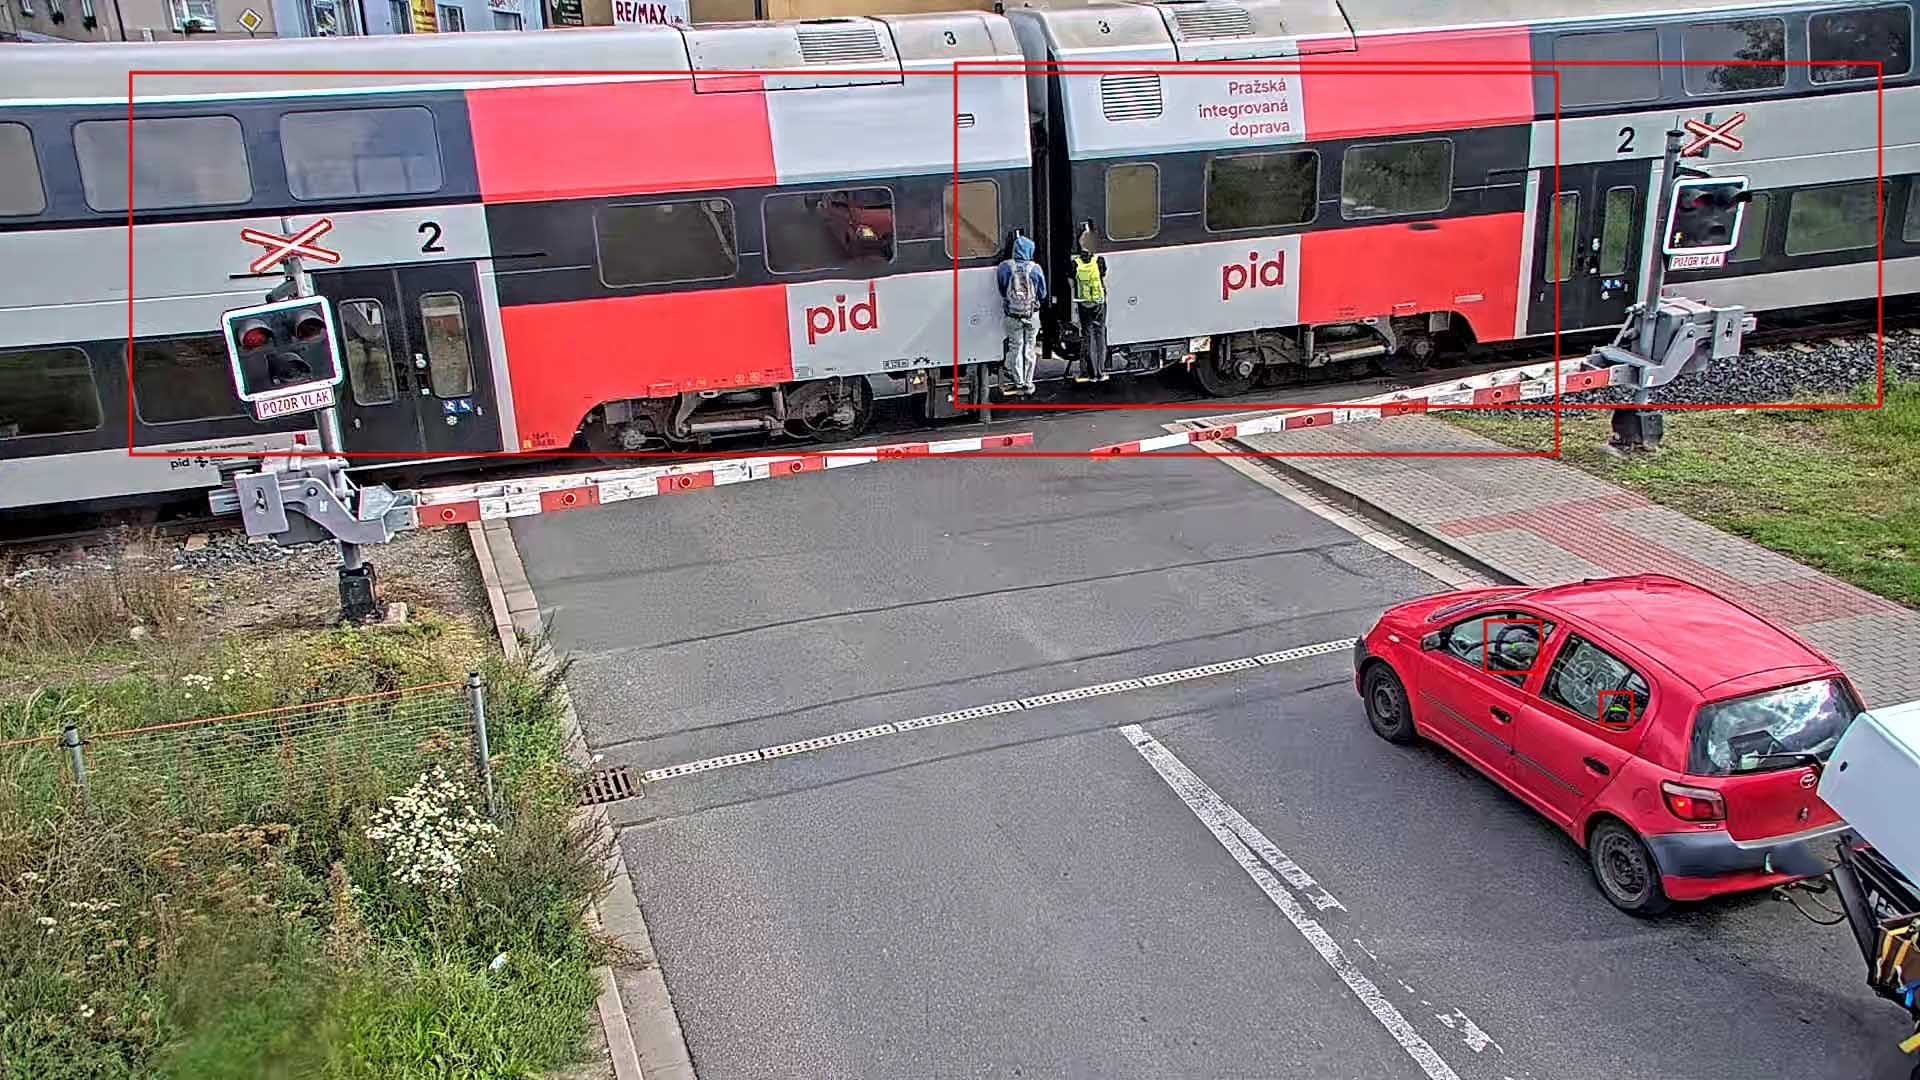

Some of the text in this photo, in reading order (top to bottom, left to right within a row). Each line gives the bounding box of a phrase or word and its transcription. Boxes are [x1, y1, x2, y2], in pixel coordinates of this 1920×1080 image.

[615, 1, 667, 25] RE/MAX
[944, 31, 957, 45] 3
[1099, 20, 1111, 34] 3
[1229, 77, 1287, 95] Pražská
[1198, 98, 1288, 119] integrovaná
[1229, 121, 1290, 138] doprava
[1617, 126, 1635, 153] 2
[418, 221, 445, 252] 2
[1222, 250, 1285, 301] pid
[806, 291, 878, 345] pid
[262, 391, 330, 415] POZOR VLAK
[170, 457, 190, 471] pid
